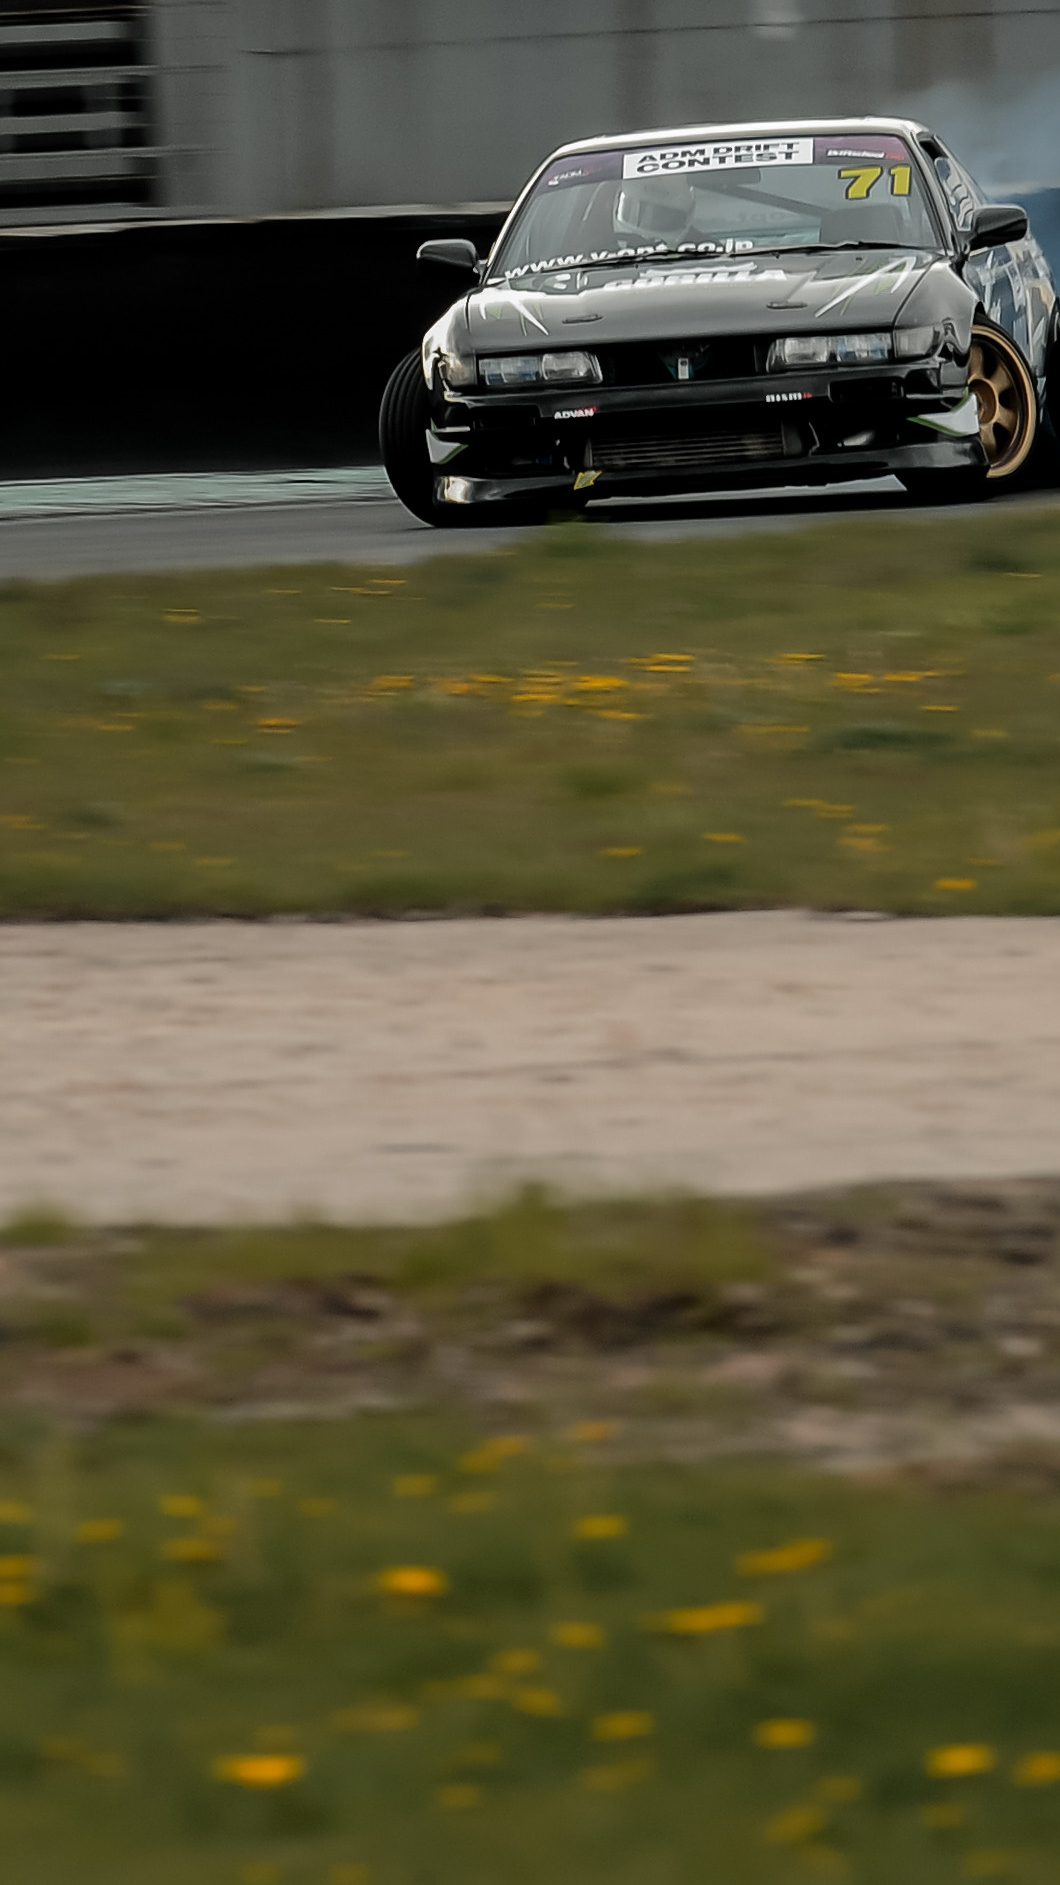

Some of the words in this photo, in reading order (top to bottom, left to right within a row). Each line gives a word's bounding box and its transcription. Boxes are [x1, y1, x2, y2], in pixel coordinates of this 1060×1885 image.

[636, 150, 800, 174] CONTEST
[639, 148, 706, 164] ADM
[713, 141, 800, 155] DRIFT
[838, 164, 912, 201] 71
